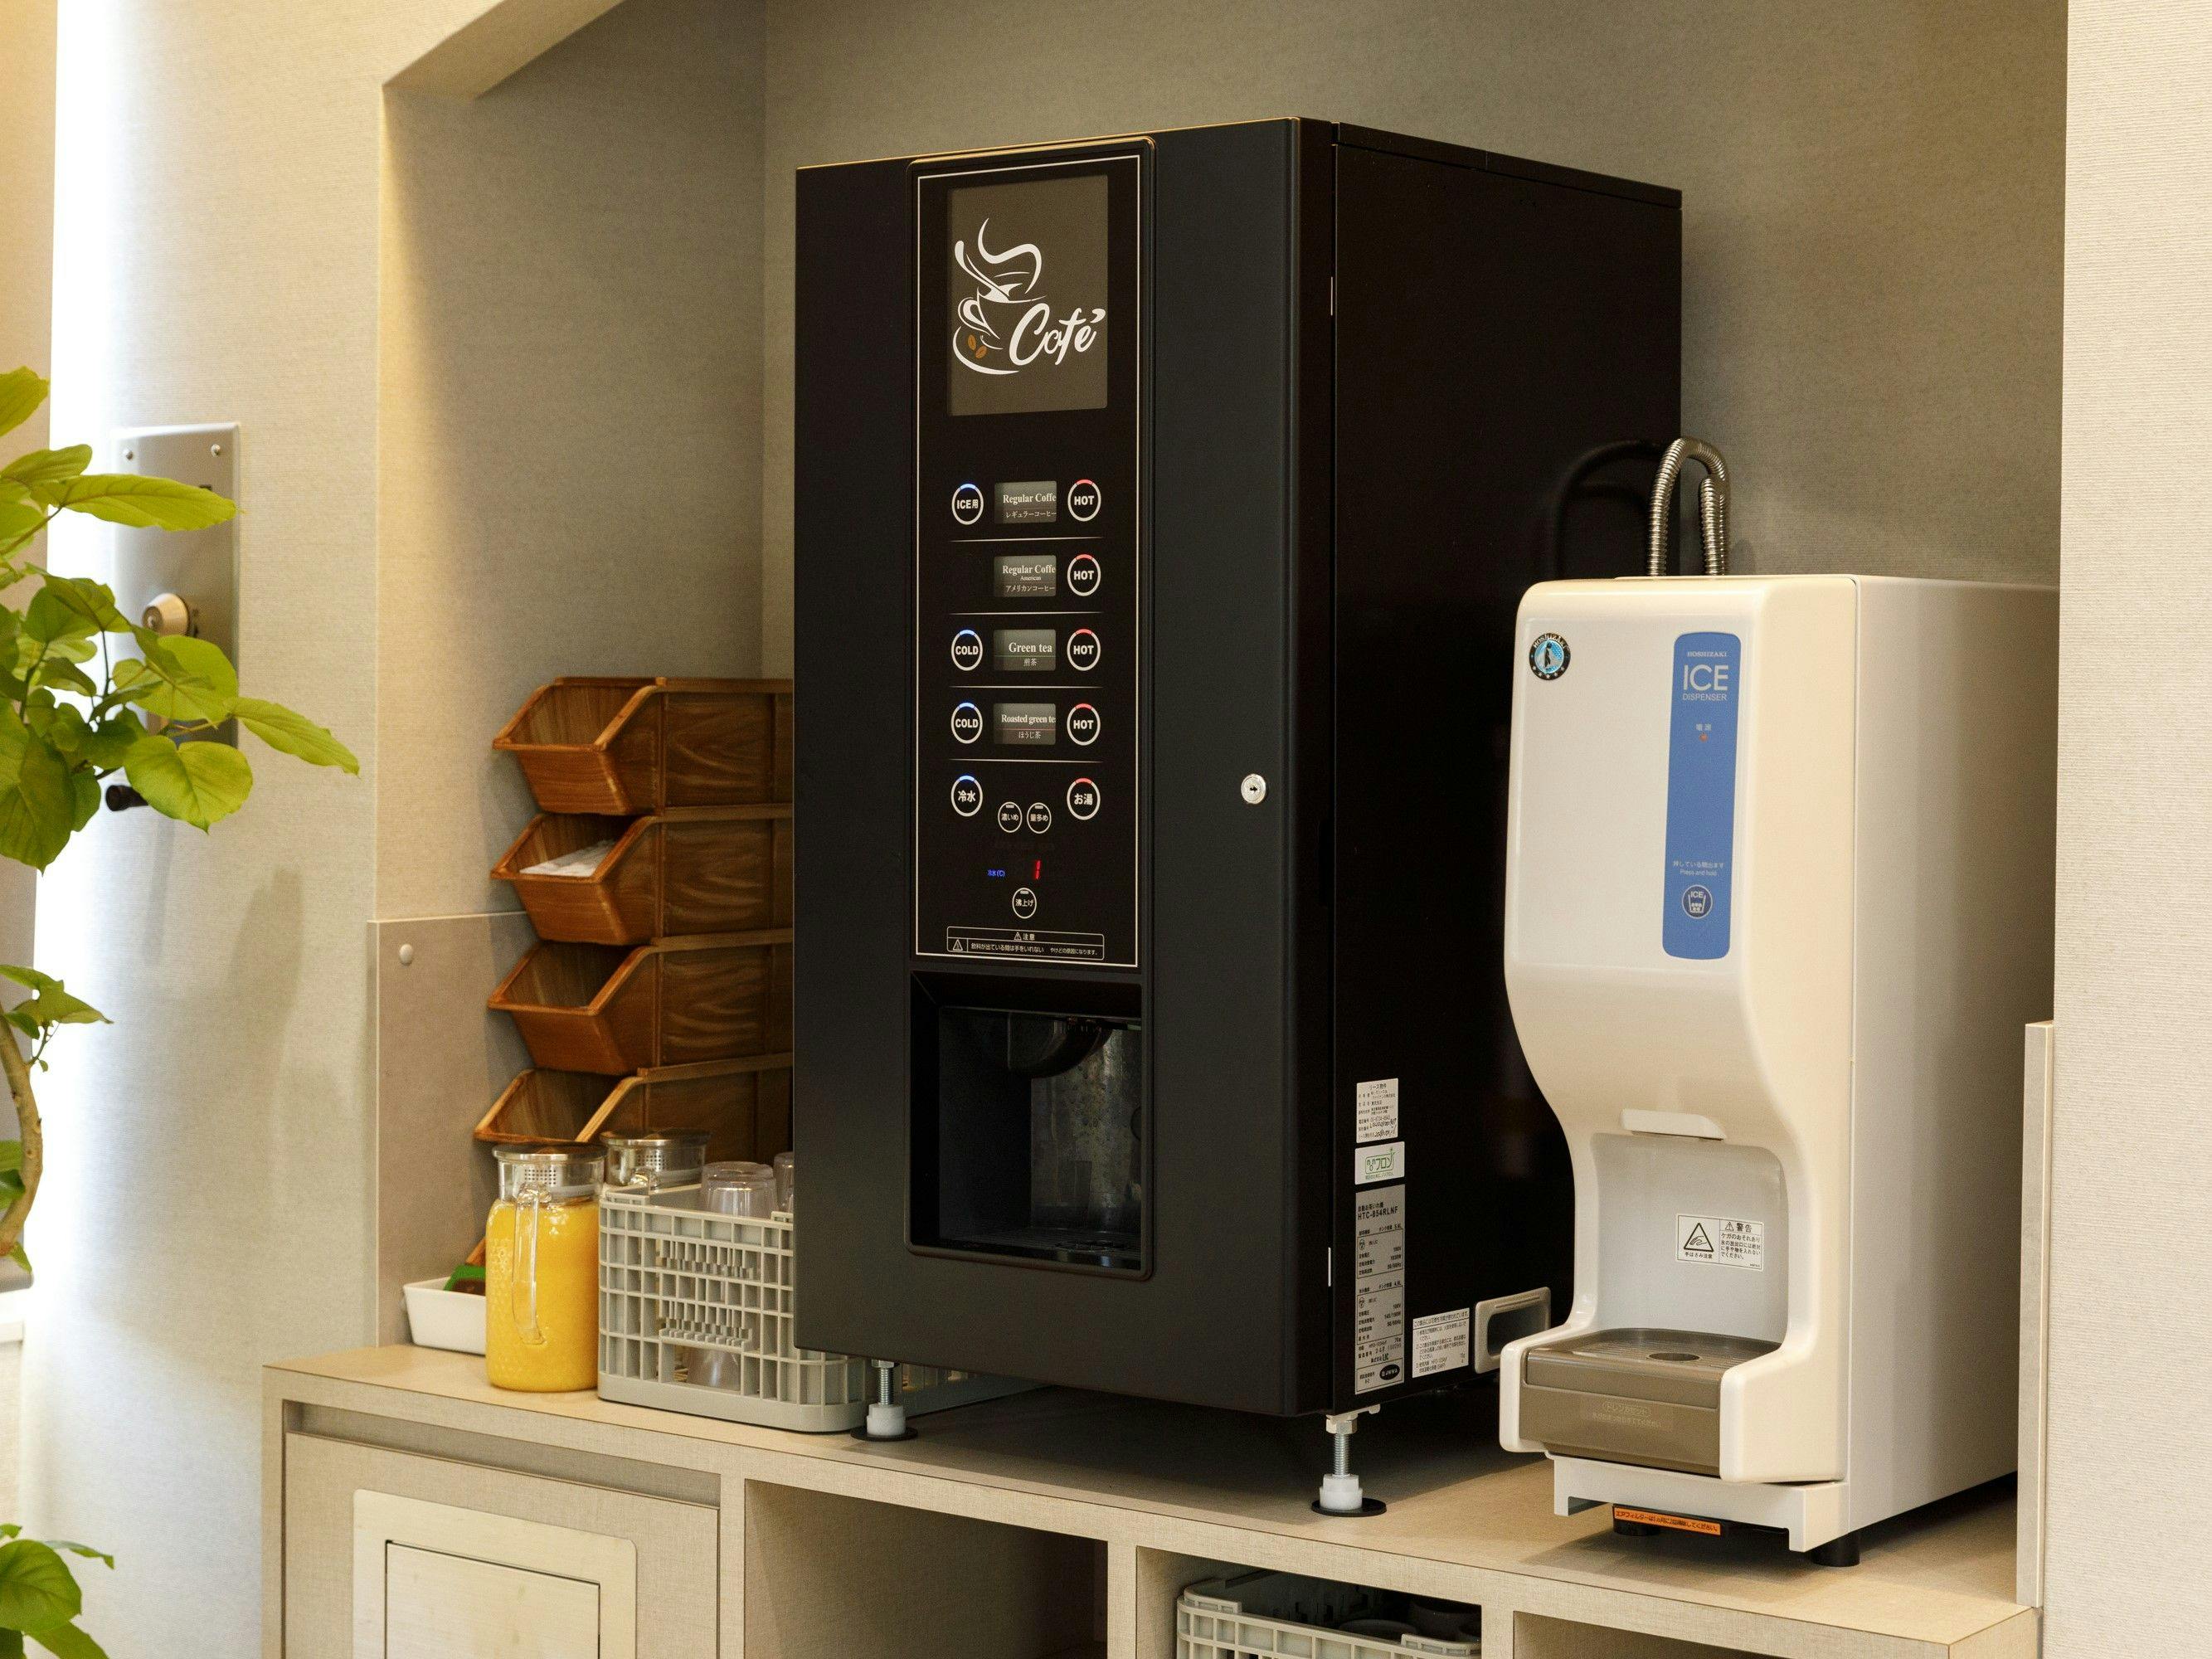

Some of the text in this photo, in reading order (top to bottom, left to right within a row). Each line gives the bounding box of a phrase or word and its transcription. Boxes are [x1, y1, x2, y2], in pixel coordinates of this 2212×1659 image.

[956, 499, 979, 509] ICE用
[1003, 494, 1033, 505] Regular
[1074, 495, 1094, 506] HOT
[1002, 565, 1033, 576] Regular
[1073, 570, 1094, 581] HOT
[955, 645, 979, 655] COLD
[1009, 642, 1053, 653] Green tea
[1073, 645, 1094, 655] HOT
[1683, 664, 1728, 691] ICE
[955, 718, 979, 728] COLD
[1001, 714, 1028, 723] Roasted
[1028, 716, 1048, 725] green
[1073, 720, 1094, 729] HOT
[1018, 731, 1041, 739] ほうじ茶
[958, 790, 976, 802] 冷水
[1074, 793, 1093, 805] お湯
[1736, 1223, 1752, 1233] 警告
[1721, 1233, 1760, 1243] ケガのおそれあり
